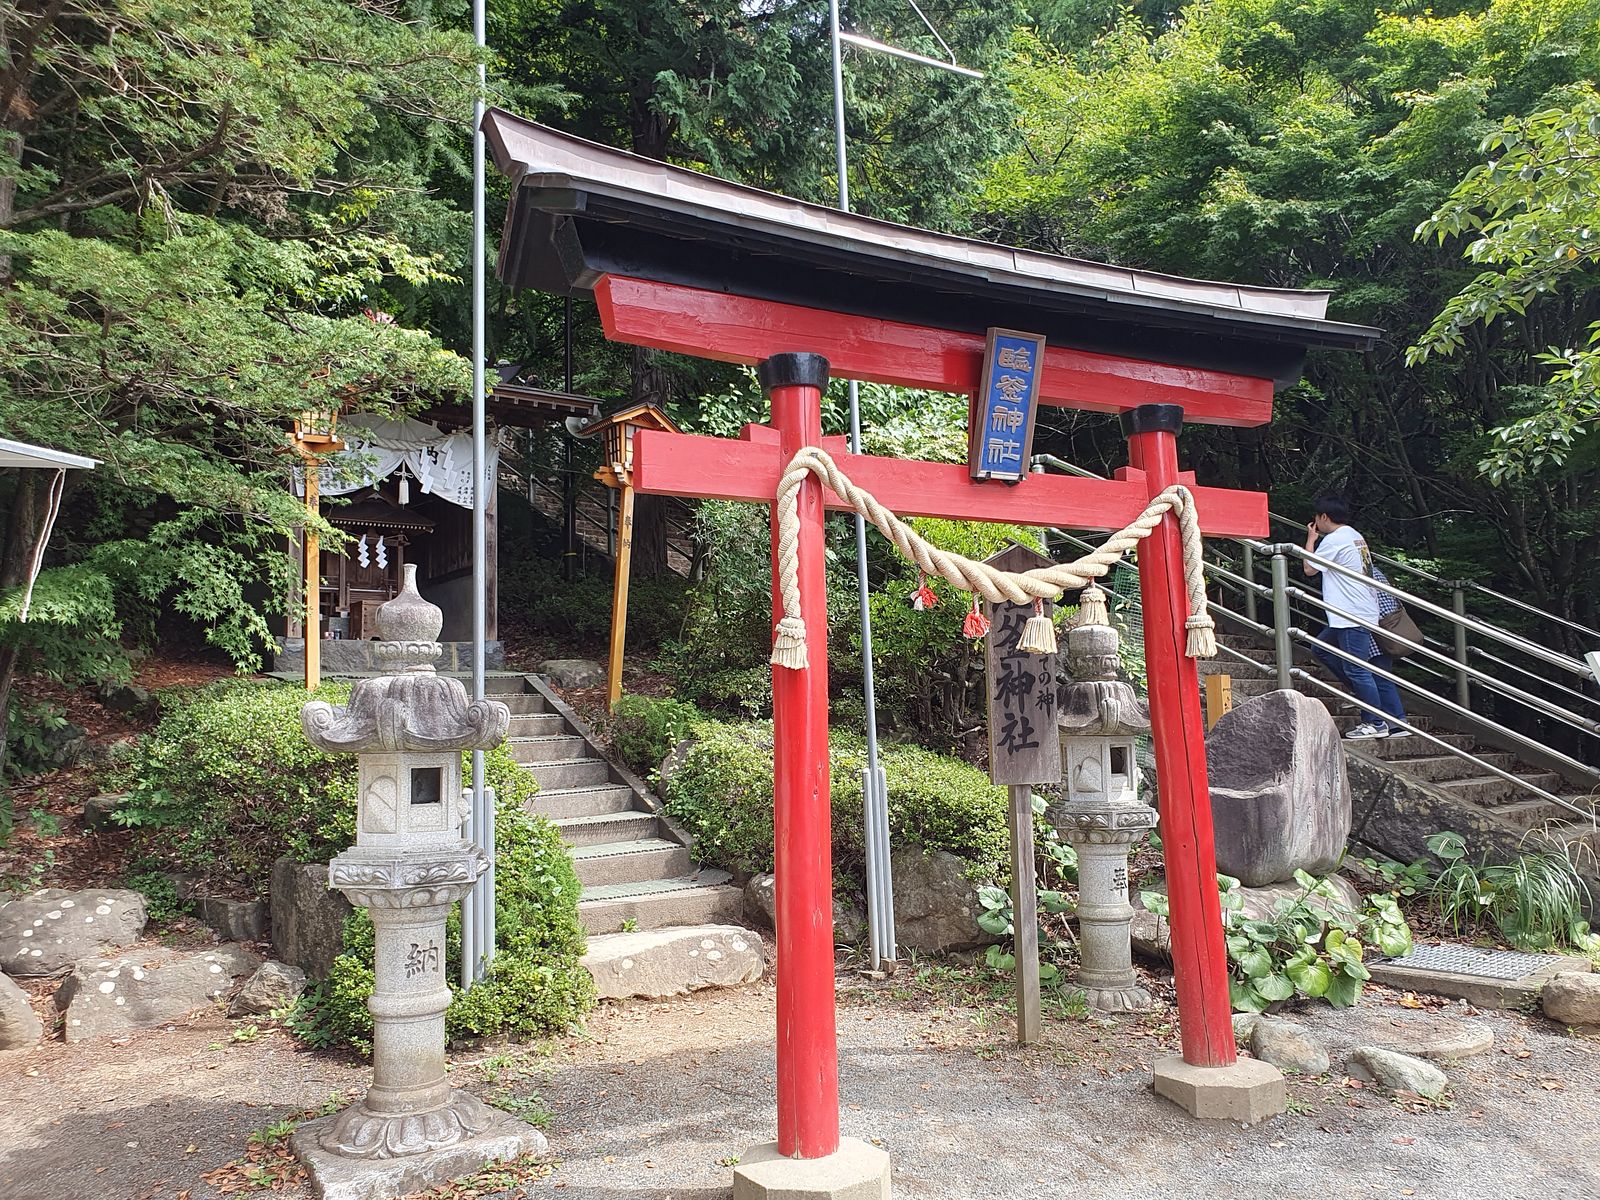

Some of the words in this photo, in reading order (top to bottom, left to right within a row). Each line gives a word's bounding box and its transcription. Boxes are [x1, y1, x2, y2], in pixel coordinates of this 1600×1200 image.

[993, 600, 1039, 756] 釜神社
[404, 939, 439, 979] 納
